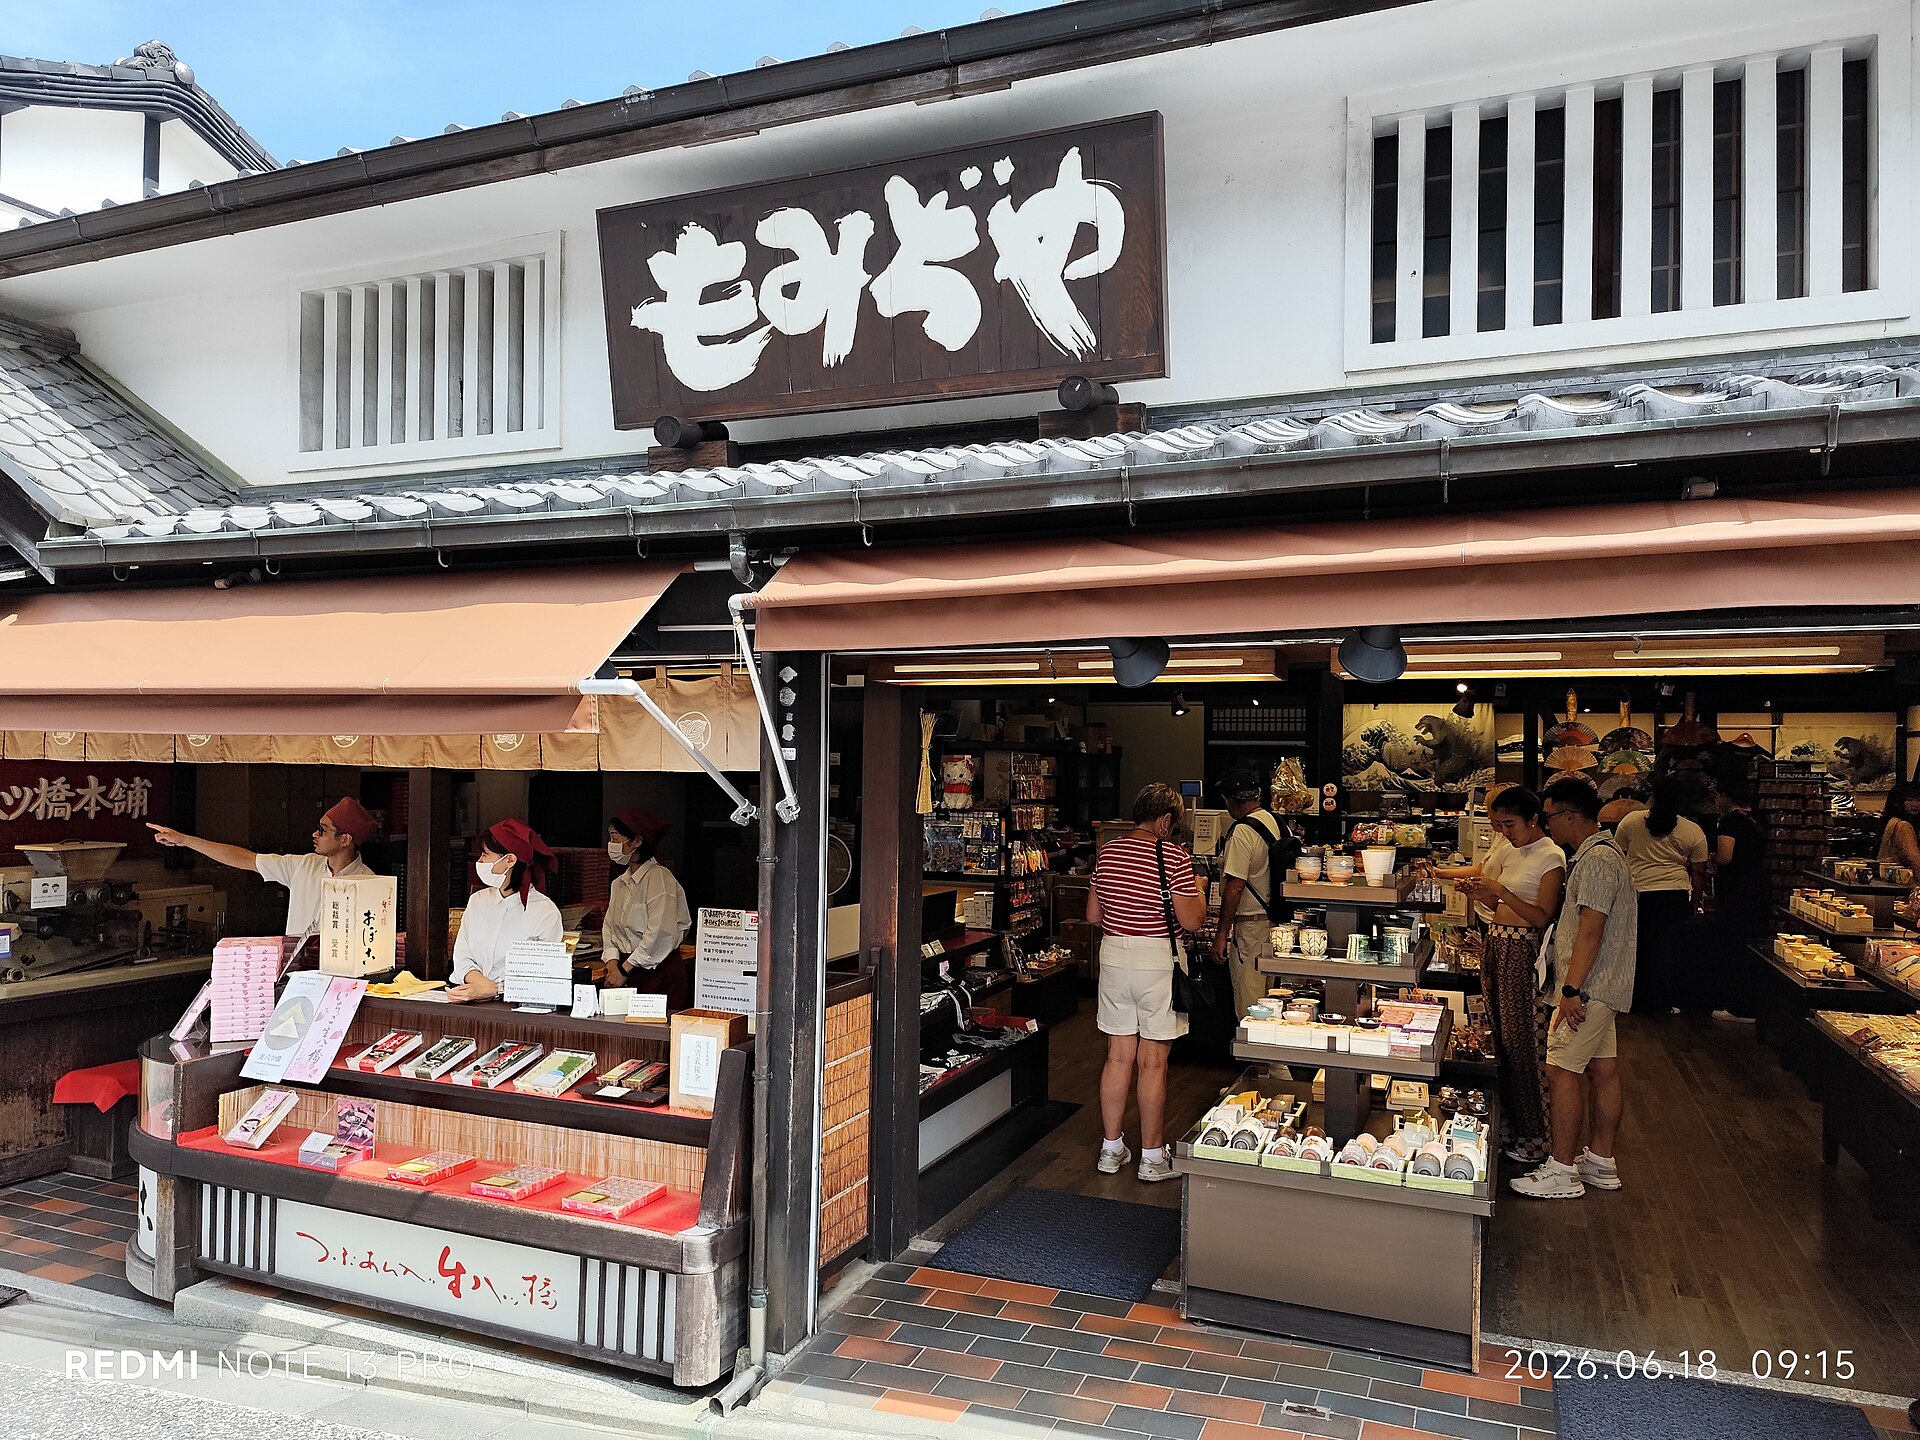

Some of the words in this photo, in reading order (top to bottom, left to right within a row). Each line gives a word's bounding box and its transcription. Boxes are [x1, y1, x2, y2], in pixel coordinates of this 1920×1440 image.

[630, 146, 1125, 392] もみぢや
[0, 775, 152, 821] ツ橋本舗
